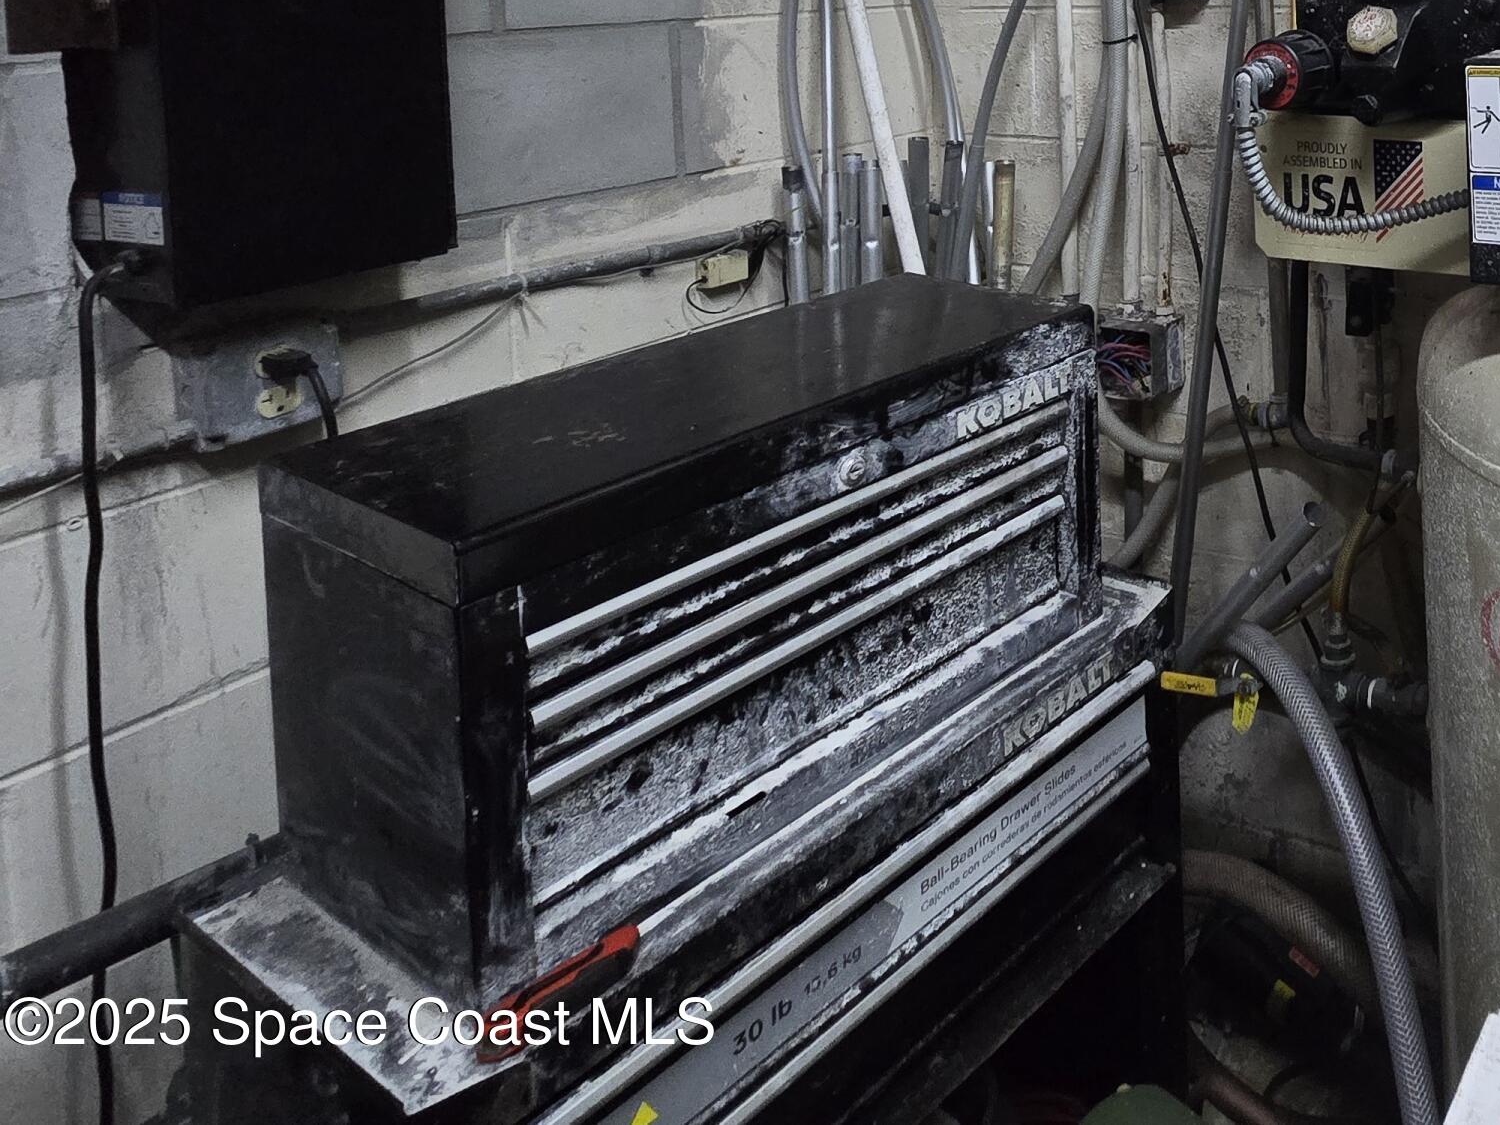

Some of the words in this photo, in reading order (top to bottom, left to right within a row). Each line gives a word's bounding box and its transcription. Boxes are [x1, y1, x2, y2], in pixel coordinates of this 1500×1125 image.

[1282, 155, 1347, 170] ASSEMBLED
[1351, 158, 1362, 170] IN
[1296, 140, 1348, 155] PROUDLY
[1283, 172, 1366, 218] USA
[957, 362, 1072, 439] KOBALT
[1003, 653, 1113, 757] KOBALT
[919, 828, 998, 896] Ball-Bearing
[1000, 790, 1043, 831] Drawer
[1043, 763, 1077, 797] Slides
[920, 876, 961, 913] Cajones
[962, 862, 981, 880] con
[1030, 810, 1043, 825] de
[733, 1018, 764, 1057] 30
[771, 998, 793, 1027] lb
[842, 945, 862, 970] kg
